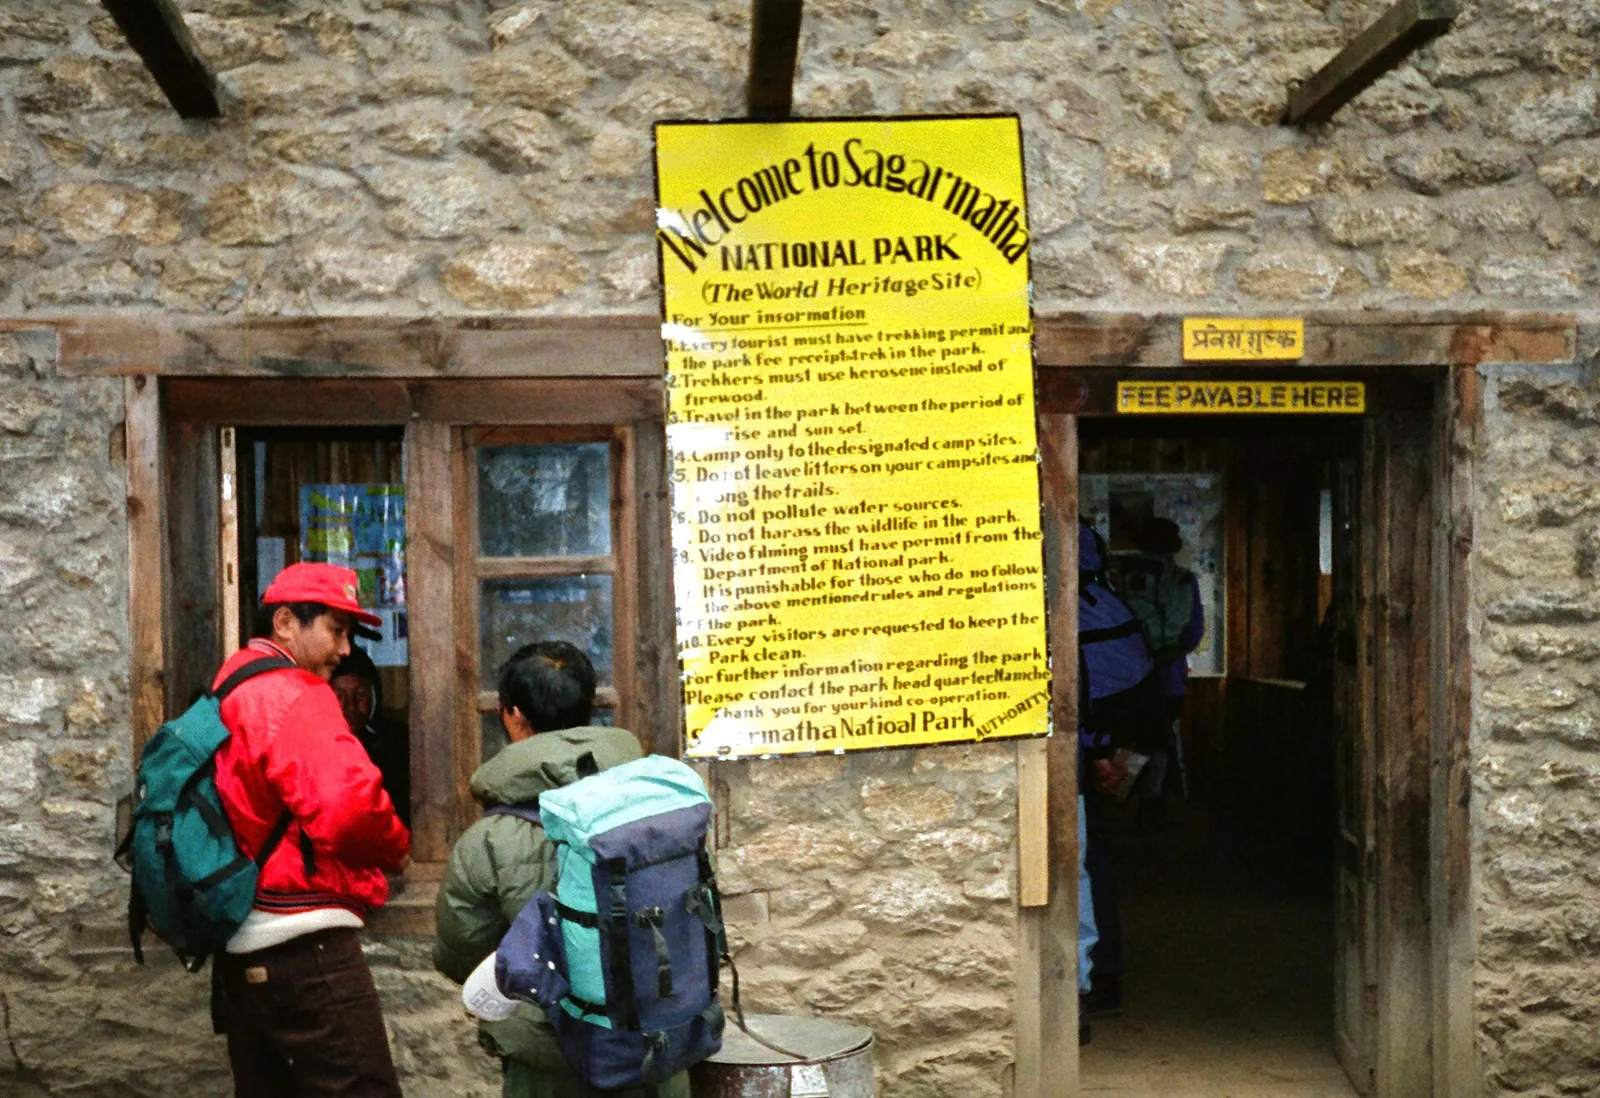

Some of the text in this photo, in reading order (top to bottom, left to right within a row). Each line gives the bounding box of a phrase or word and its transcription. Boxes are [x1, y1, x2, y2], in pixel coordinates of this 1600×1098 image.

[657, 138, 1031, 274] Welcome to Sagarmatha
[720, 233, 961, 272] NATIONAL PARK
[701, 267, 983, 303] (The World Heritage Site)
[672, 313, 702, 327] For
[709, 312, 751, 326] Your
[731, 335, 788, 349] tourist
[794, 333, 832, 346] must
[836, 332, 873, 344] have
[877, 327, 946, 342] trekking
[949, 322, 1005, 341] permit
[1007, 321, 1033, 335] and
[682, 356, 706, 370] the
[712, 353, 751, 370] park
[756, 352, 782, 367] fee
[889, 346, 906, 359] in
[909, 345, 936, 358] the
[941, 341, 986, 360] park.
[769, 368, 811, 384] must
[818, 370, 845, 382] use
[849, 366, 928, 380] kerosene
[930, 359, 983, 375] instead
[987, 358, 1008, 371] of
[744, 407, 762, 420] in
[765, 405, 792, 420] the
[796, 402, 840, 421] park
[844, 401, 919, 416] between
[921, 398, 948, 411] the
[950, 393, 1004, 413] period
[1007, 393, 1025, 406] of
[1121, 384, 1360, 408] FEE PAYABLE HERE
[767, 423, 798, 439] and
[804, 425, 834, 437] sun
[745, 444, 784, 461] only
[788, 443, 806, 457] to
[808, 441, 834, 456] the
[836, 436, 930, 458] designated
[696, 466, 719, 482] Do
[756, 463, 801, 480] leave
[803, 459, 858, 477] litters
[860, 462, 882, 474] on
[885, 460, 923, 476] your
[753, 485, 782, 501] the
[784, 482, 840, 499] trails.
[698, 509, 721, 525] Do
[726, 507, 756, 523] not
[762, 504, 828, 524] pollute
[833, 499, 889, 516] water
[892, 499, 963, 514] sources.
[698, 509, 1020, 544] Do not harass the wildlife in the park.
[699, 547, 747, 563] Video
[748, 543, 808, 561] filming
[813, 538, 854, 555] must
[859, 538, 899, 551] have
[902, 531, 962, 551] permit
[965, 530, 1009, 545] from
[1012, 526, 1041, 541] the
[703, 550, 954, 581] Department of National park.
[719, 582, 732, 597] is
[735, 577, 827, 600] punishable
[830, 575, 855, 590] for
[859, 573, 904, 587] those
[909, 569, 941, 584] who
[945, 567, 964, 581] do
[970, 566, 989, 579] no
[991, 562, 1040, 577] follow
[705, 580, 1037, 613] the above mentioned rules and regulations
[706, 633, 756, 648] Every
[762, 629, 827, 644] visitors
[831, 626, 860, 639] are
[863, 617, 945, 638] requested
[948, 616, 965, 631] to
[968, 614, 1008, 630] keep
[1011, 611, 1040, 626] the
[707, 617, 733, 631] the
[737, 613, 782, 632] park.
[709, 647, 807, 665] Park clean.
[716, 666, 779, 684] further
[782, 658, 884, 678] information
[886, 652, 969, 673] regarding
[972, 650, 998, 665] the
[1001, 647, 1042, 666] park
[686, 690, 744, 705] Please
[749, 681, 815, 701] contact
[819, 679, 845, 696] the
[849, 676, 889, 697] park
[893, 673, 931, 691] head
[771, 704, 800, 718] you
[803, 701, 827, 714] for
[831, 699, 868, 716] your
[868, 694, 903, 709] kind
[840, 712, 916, 739] Natioal
[922, 707, 976, 733] Park
[975, 689, 1051, 739] AUTHORITY
